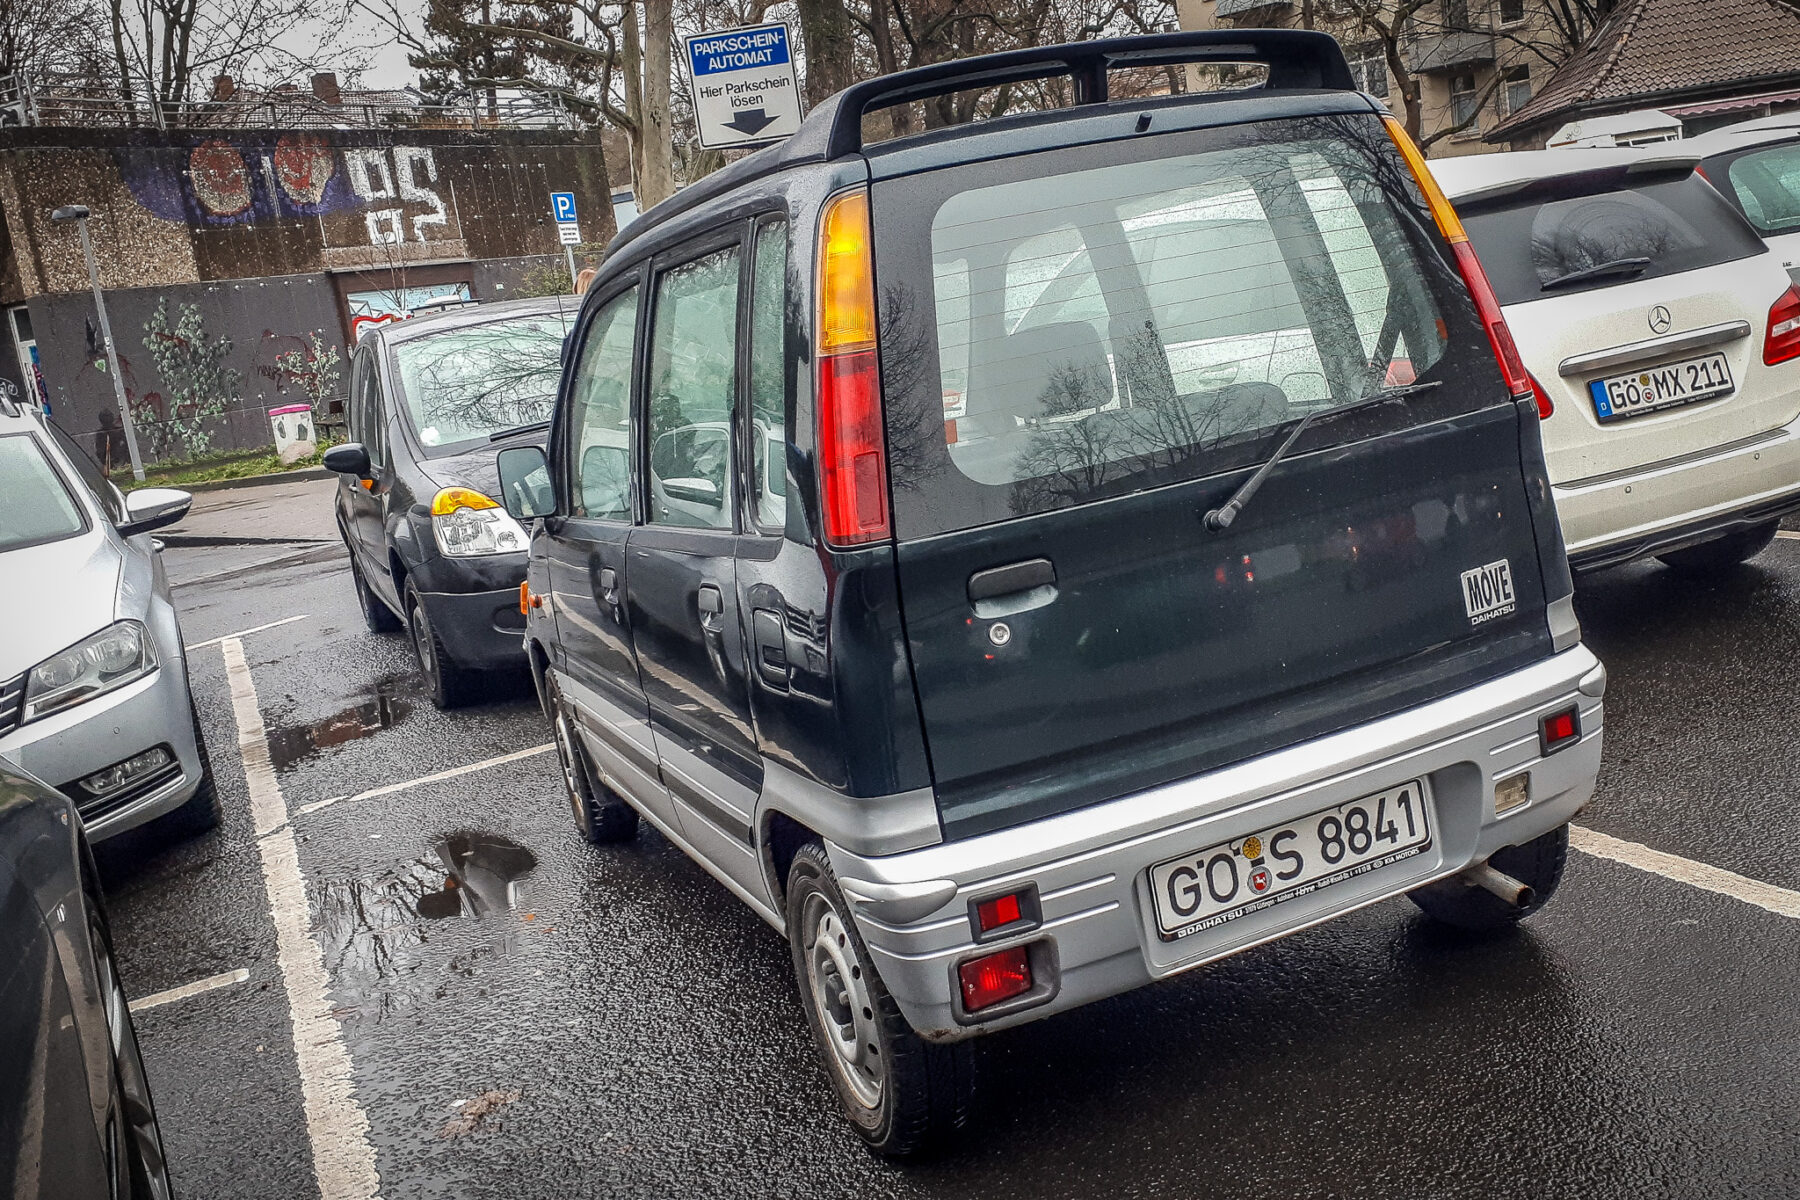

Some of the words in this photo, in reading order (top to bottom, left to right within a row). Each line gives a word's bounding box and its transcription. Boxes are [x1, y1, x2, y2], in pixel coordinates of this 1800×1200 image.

[693, 31, 784, 57] PARKSCHEIN-
[708, 48, 773, 71] AUTOMAT
[699, 86, 723, 99] Hier
[725, 76, 790, 95] Parkschein
[730, 95, 764, 108] lösen
[556, 196, 570, 219] P
[1607, 377, 1641, 410] GÖ
[1652, 368, 1686, 400] MX
[1686, 359, 1729, 392] 211
[1467, 565, 1511, 612] MOVE
[1471, 603, 1516, 626] DAIHATSU
[1317, 790, 1416, 864] 8841
[1186, 909, 1244, 935] DAIHATSU
[1384, 857, 1395, 865] KIA
[1395, 847, 1420, 861] MOTORS
